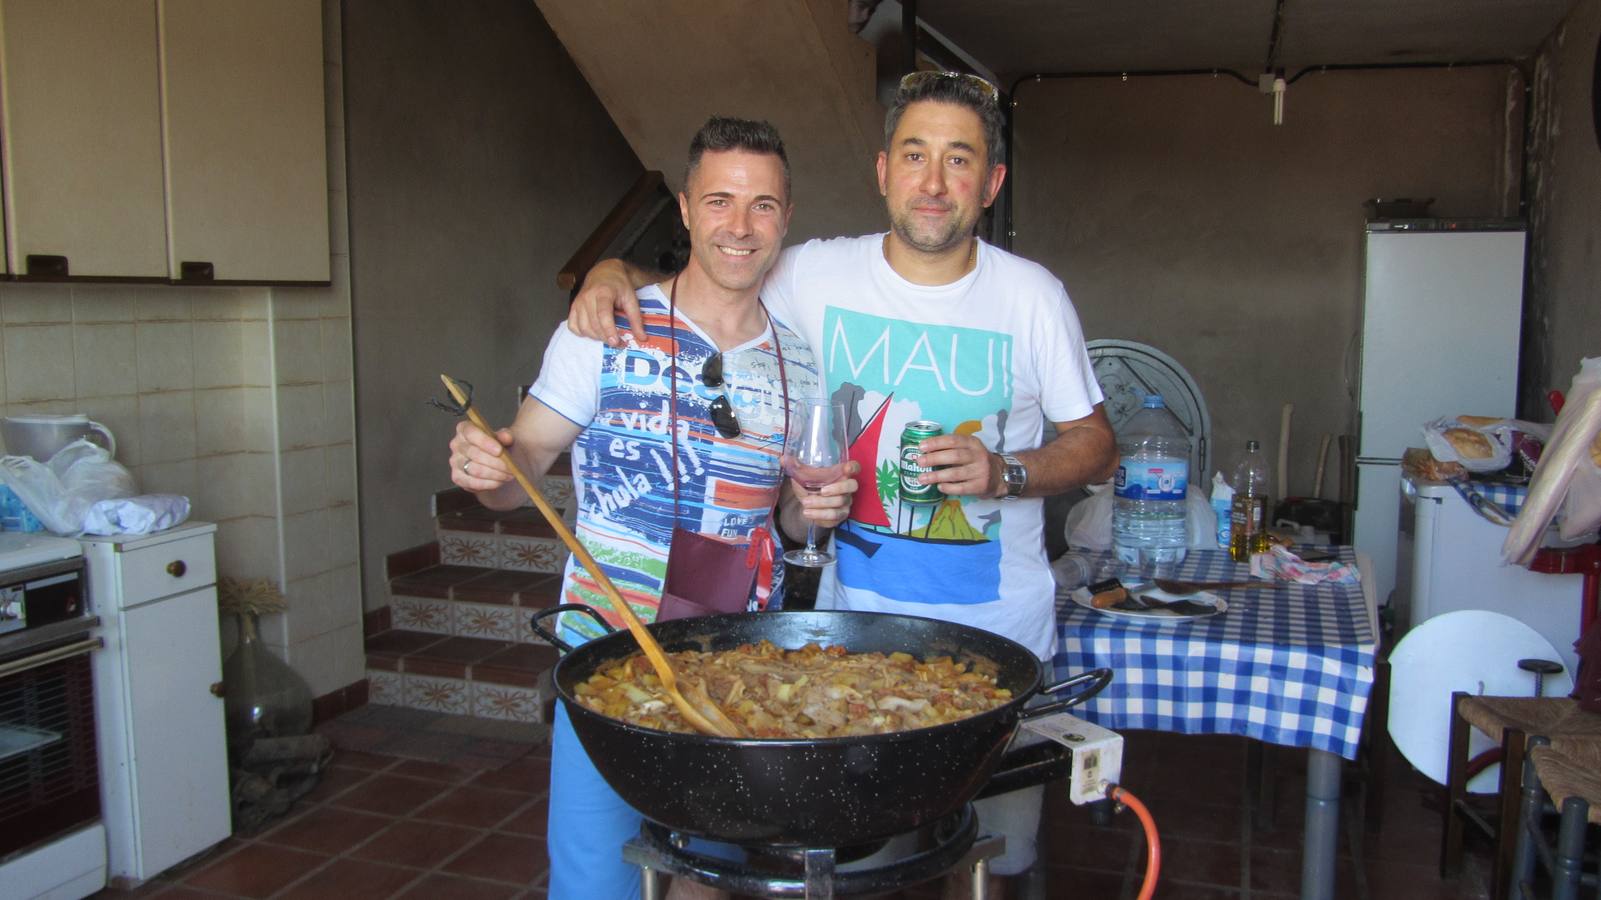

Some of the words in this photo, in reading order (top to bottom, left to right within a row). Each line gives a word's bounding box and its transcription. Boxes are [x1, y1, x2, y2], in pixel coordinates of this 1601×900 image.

[829, 314, 1009, 398] MAUI
[620, 399, 690, 442] vida
[608, 437, 641, 461] es
[721, 528, 738, 538] FUN
[724, 518, 748, 527] LOVE
